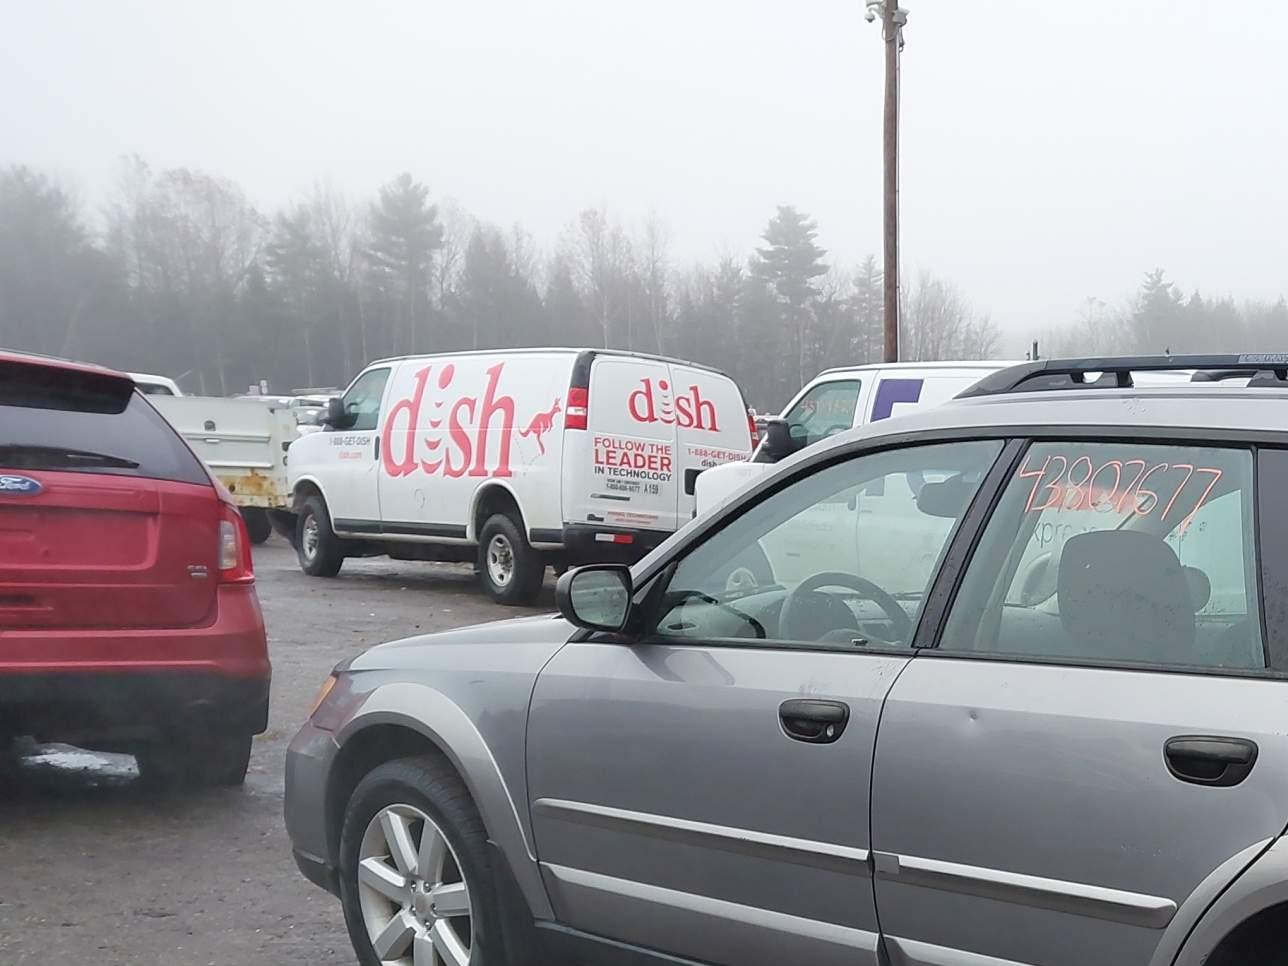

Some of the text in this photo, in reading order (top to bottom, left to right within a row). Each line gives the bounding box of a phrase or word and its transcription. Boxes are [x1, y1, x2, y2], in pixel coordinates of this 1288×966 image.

[382, 362, 513, 478] dish
[628, 377, 721, 432] dish
[594, 437, 672, 456] FOLLOW THE
[594, 449, 672, 473] LEADER
[594, 466, 605, 475] IN
[607, 467, 672, 482] TECHNOLOGY
[1019, 455, 1223, 536] 43807677
